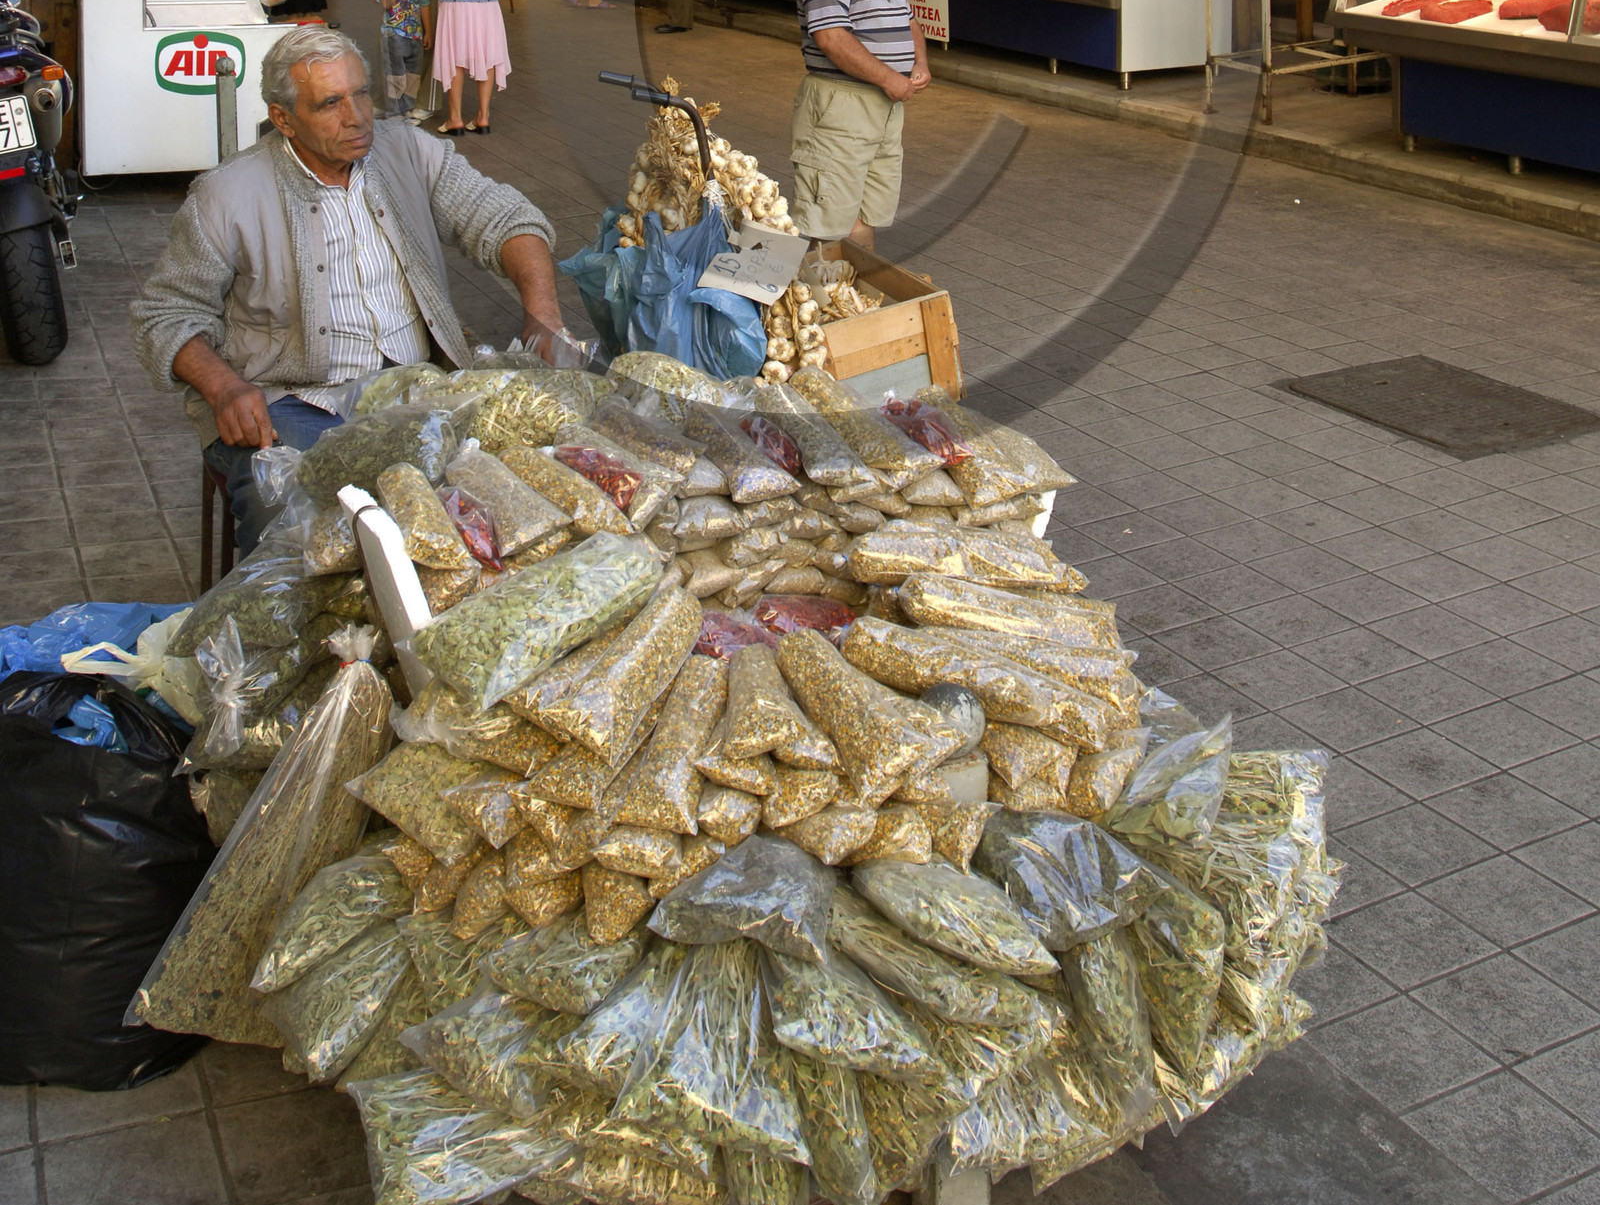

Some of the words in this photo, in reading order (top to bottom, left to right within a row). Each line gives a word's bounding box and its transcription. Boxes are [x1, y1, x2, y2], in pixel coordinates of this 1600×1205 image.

[910, 3, 941, 22] ΙΤΣΕΛ
[920, 23, 946, 38] ΟΥΛΑΣ
[713, 256, 741, 277] 15
